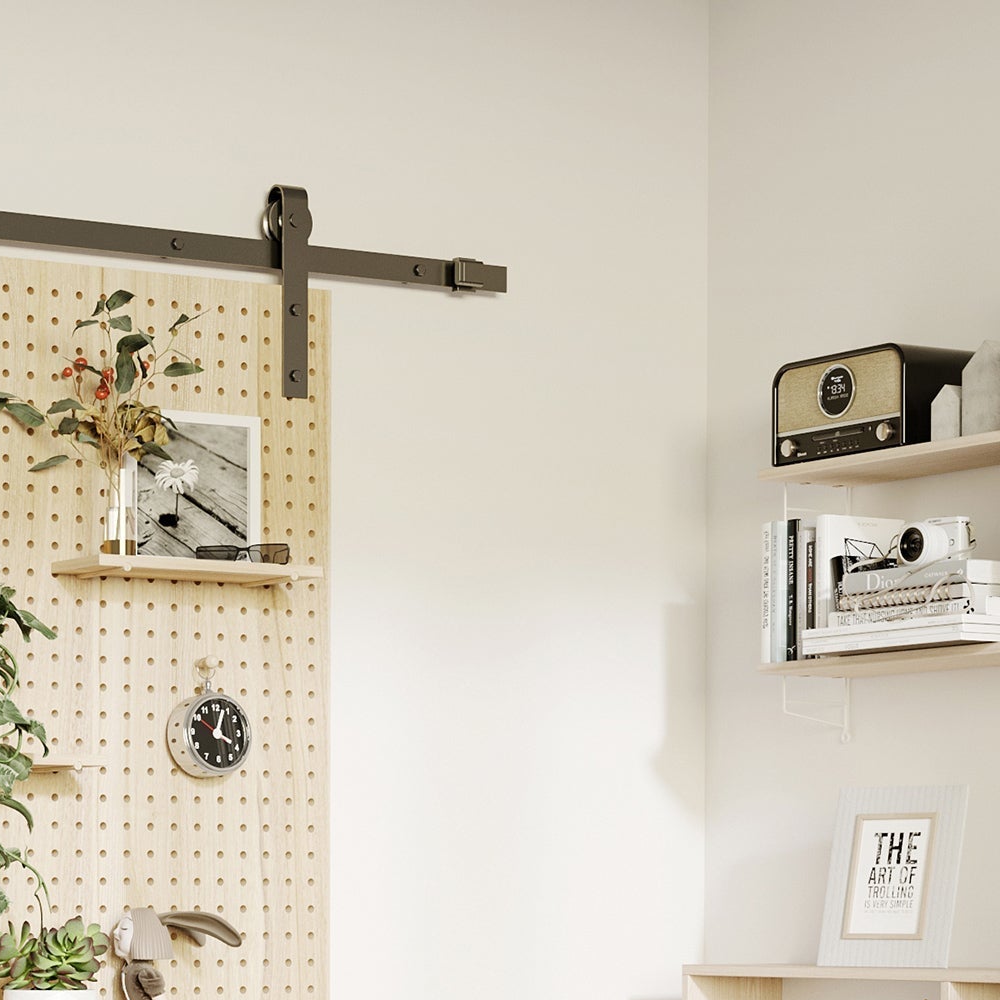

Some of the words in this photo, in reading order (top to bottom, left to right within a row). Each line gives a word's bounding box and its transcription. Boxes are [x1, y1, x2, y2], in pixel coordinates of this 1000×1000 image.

[874, 832, 922, 864] THE
[868, 866, 895, 884] ART
[900, 866, 918, 884] OF
[868, 886, 914, 899] TROLLING
[864, 900, 871, 909] IS
[872, 900, 888, 909] VERY
[889, 900, 914, 909] SIMPLE
